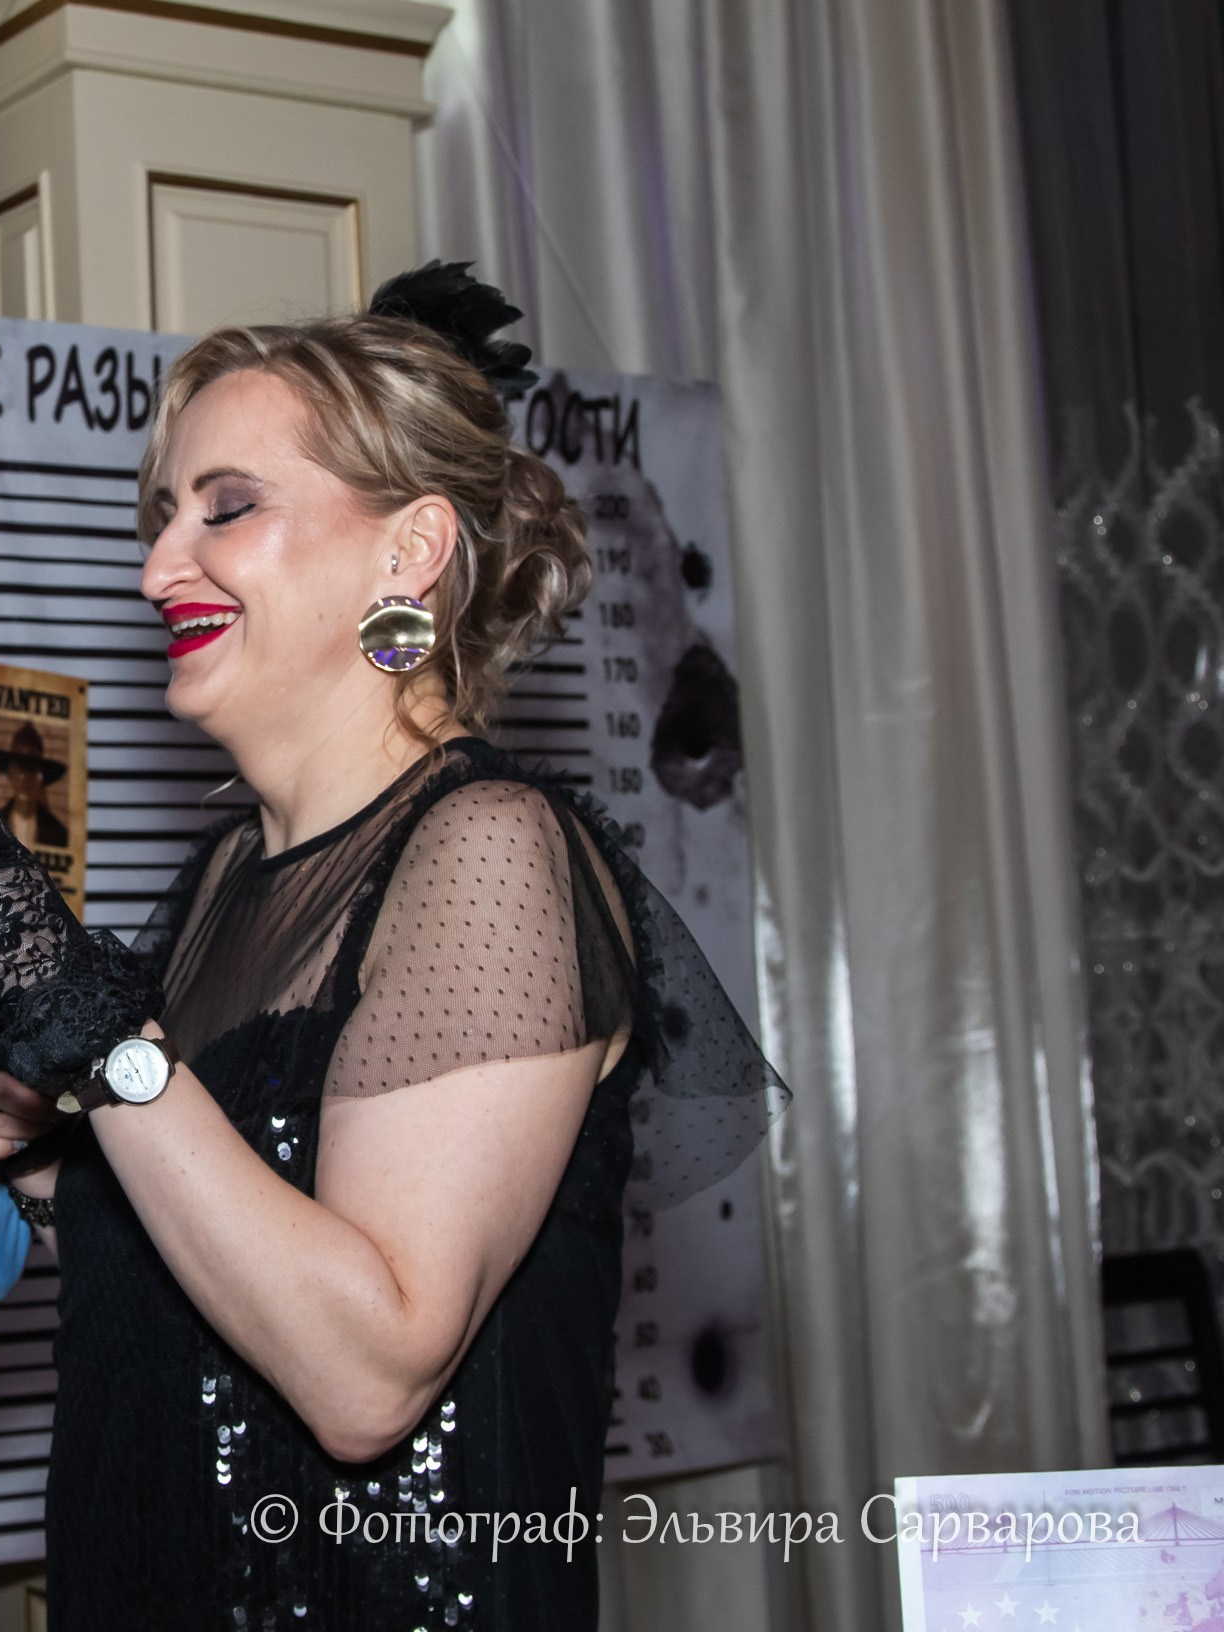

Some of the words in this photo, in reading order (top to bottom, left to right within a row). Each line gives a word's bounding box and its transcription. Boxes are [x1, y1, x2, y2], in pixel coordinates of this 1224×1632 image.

[26, 343, 162, 431] РАЗЫ
[596, 548, 631, 575] 190
[599, 603, 635, 629] 180
[603, 657, 637, 684] 170
[605, 712, 640, 738] 160
[608, 767, 643, 794] 150
[1064, 1488, 1081, 1496] FOR
[1083, 1487, 1112, 1496] MOTION
[1114, 1486, 1147, 1494] PICTURE
[1166, 1484, 1187, 1492] ONLY
[930, 1494, 970, 1514] 500
